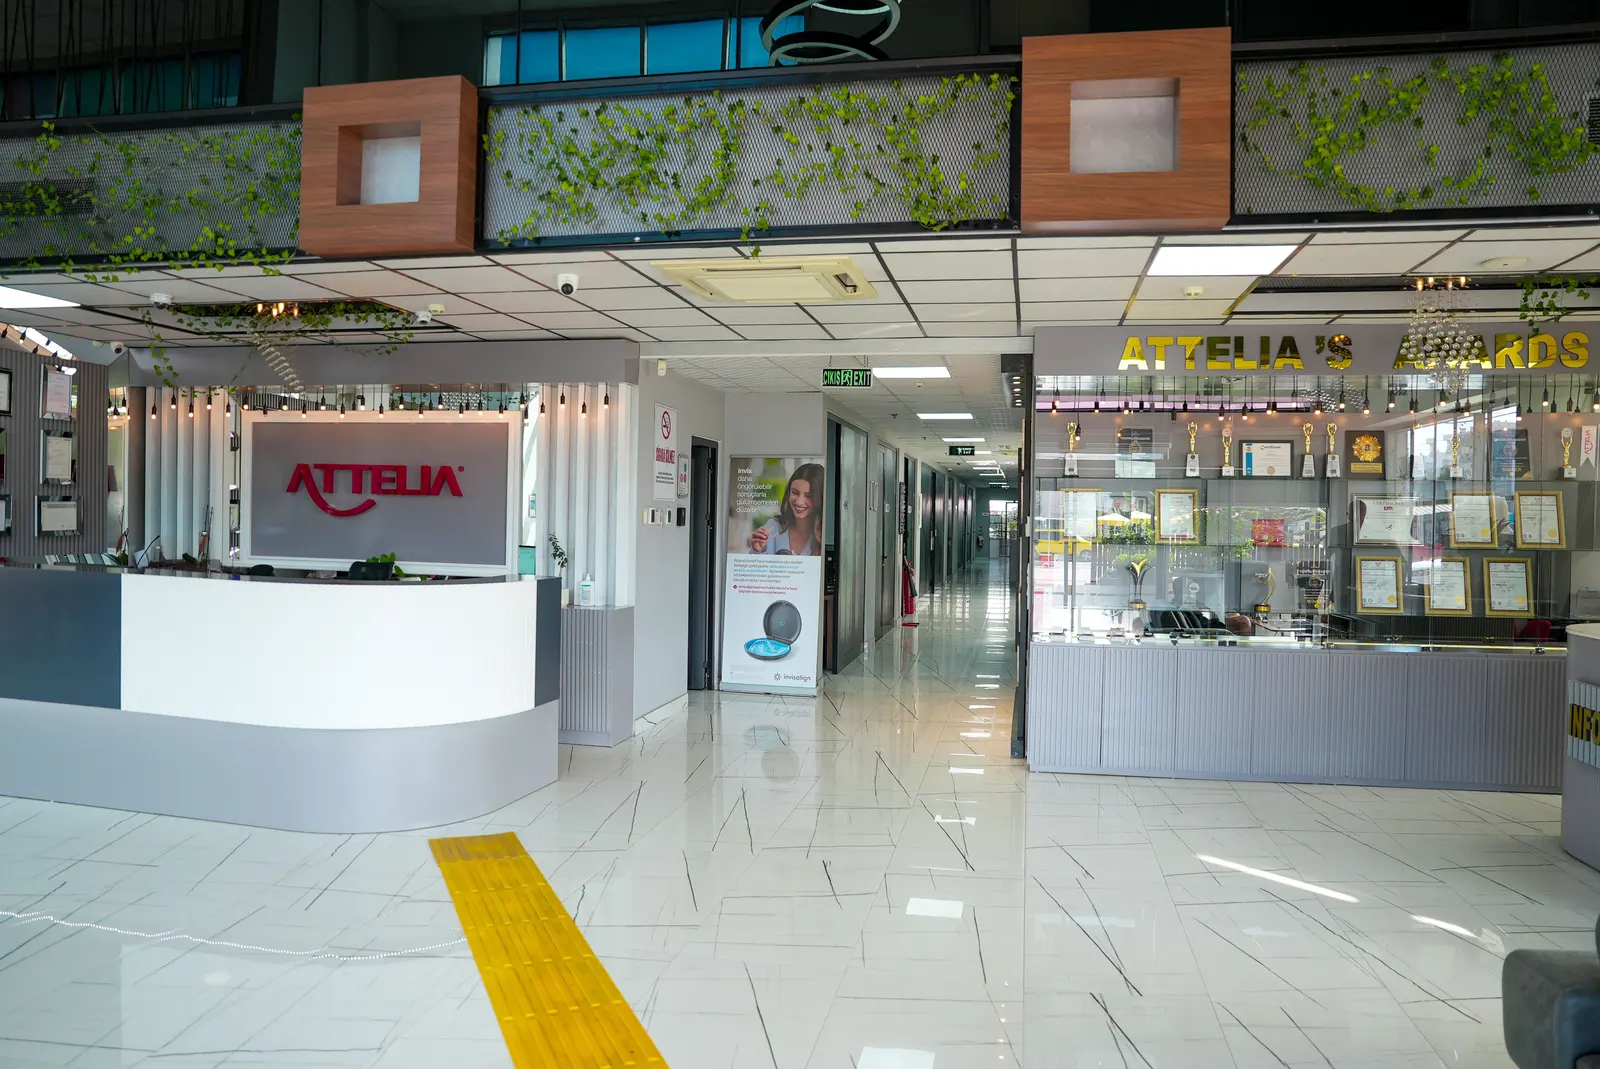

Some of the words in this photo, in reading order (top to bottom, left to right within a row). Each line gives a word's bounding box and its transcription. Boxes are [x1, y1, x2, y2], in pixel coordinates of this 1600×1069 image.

[1117, 335, 1353, 370] ATTELIA'S
[853, 371, 871, 385] EXIT
[783, 673, 811, 682] invisalign
